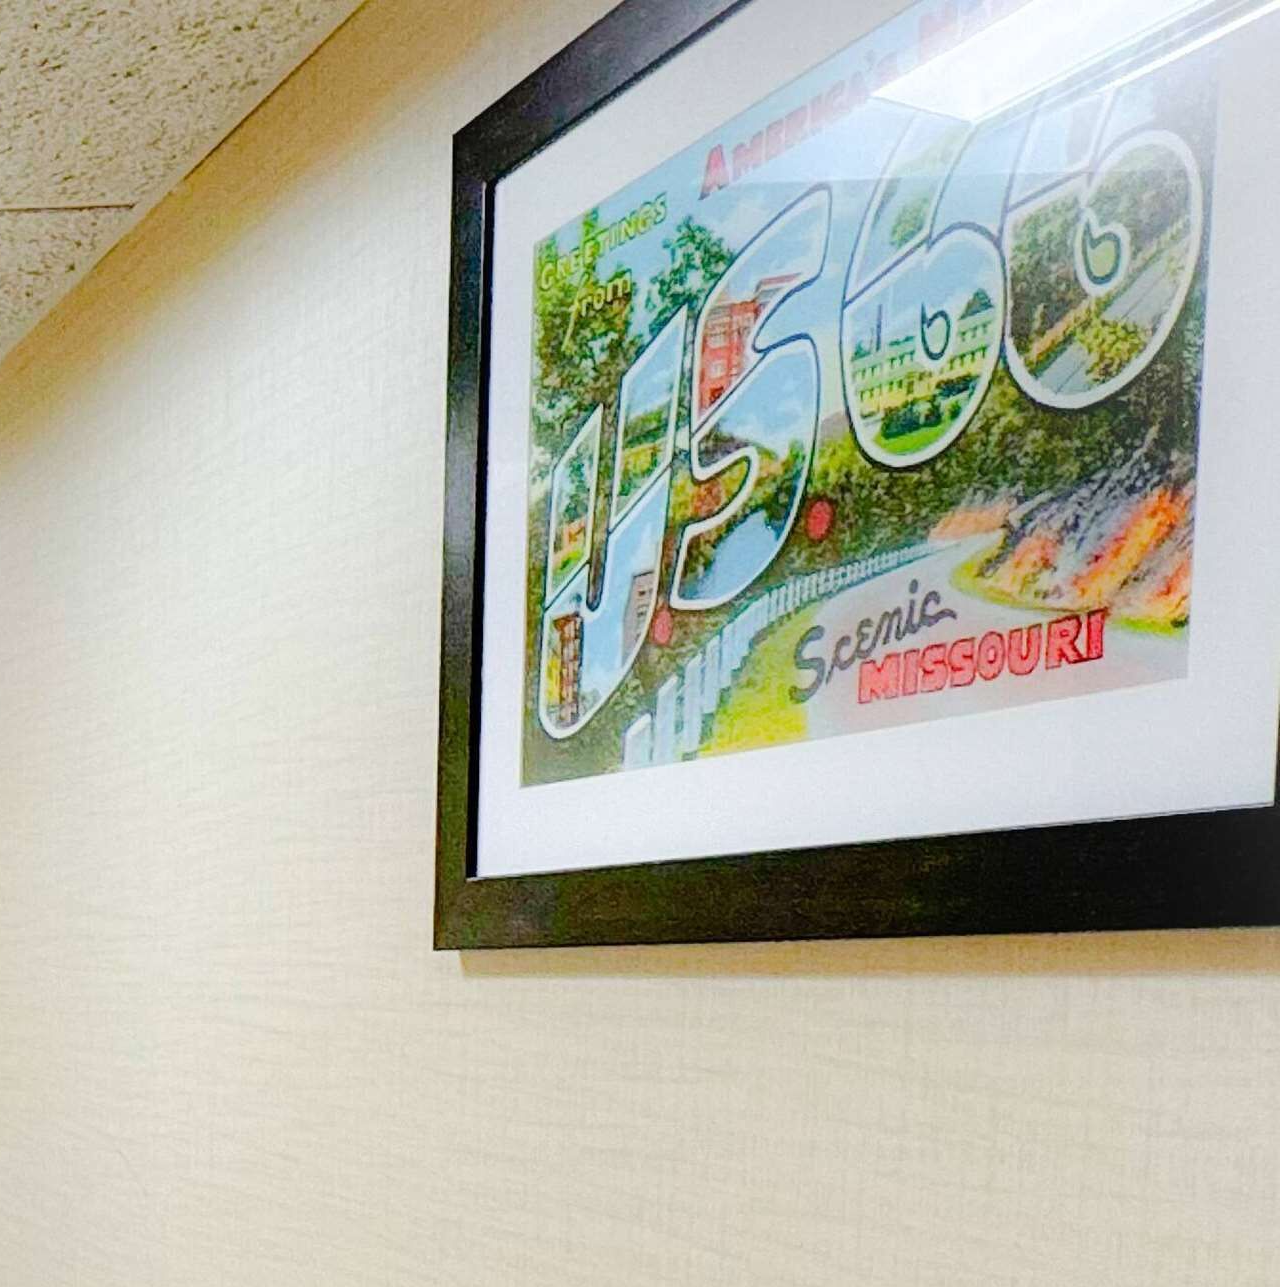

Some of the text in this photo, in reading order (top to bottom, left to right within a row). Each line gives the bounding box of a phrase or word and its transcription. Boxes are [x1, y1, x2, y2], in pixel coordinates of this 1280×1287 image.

[541, 190, 668, 291] GREETINGS
[561, 267, 633, 352] from
[789, 578, 958, 703] Scenic
[857, 606, 1108, 704] MISSOURI
